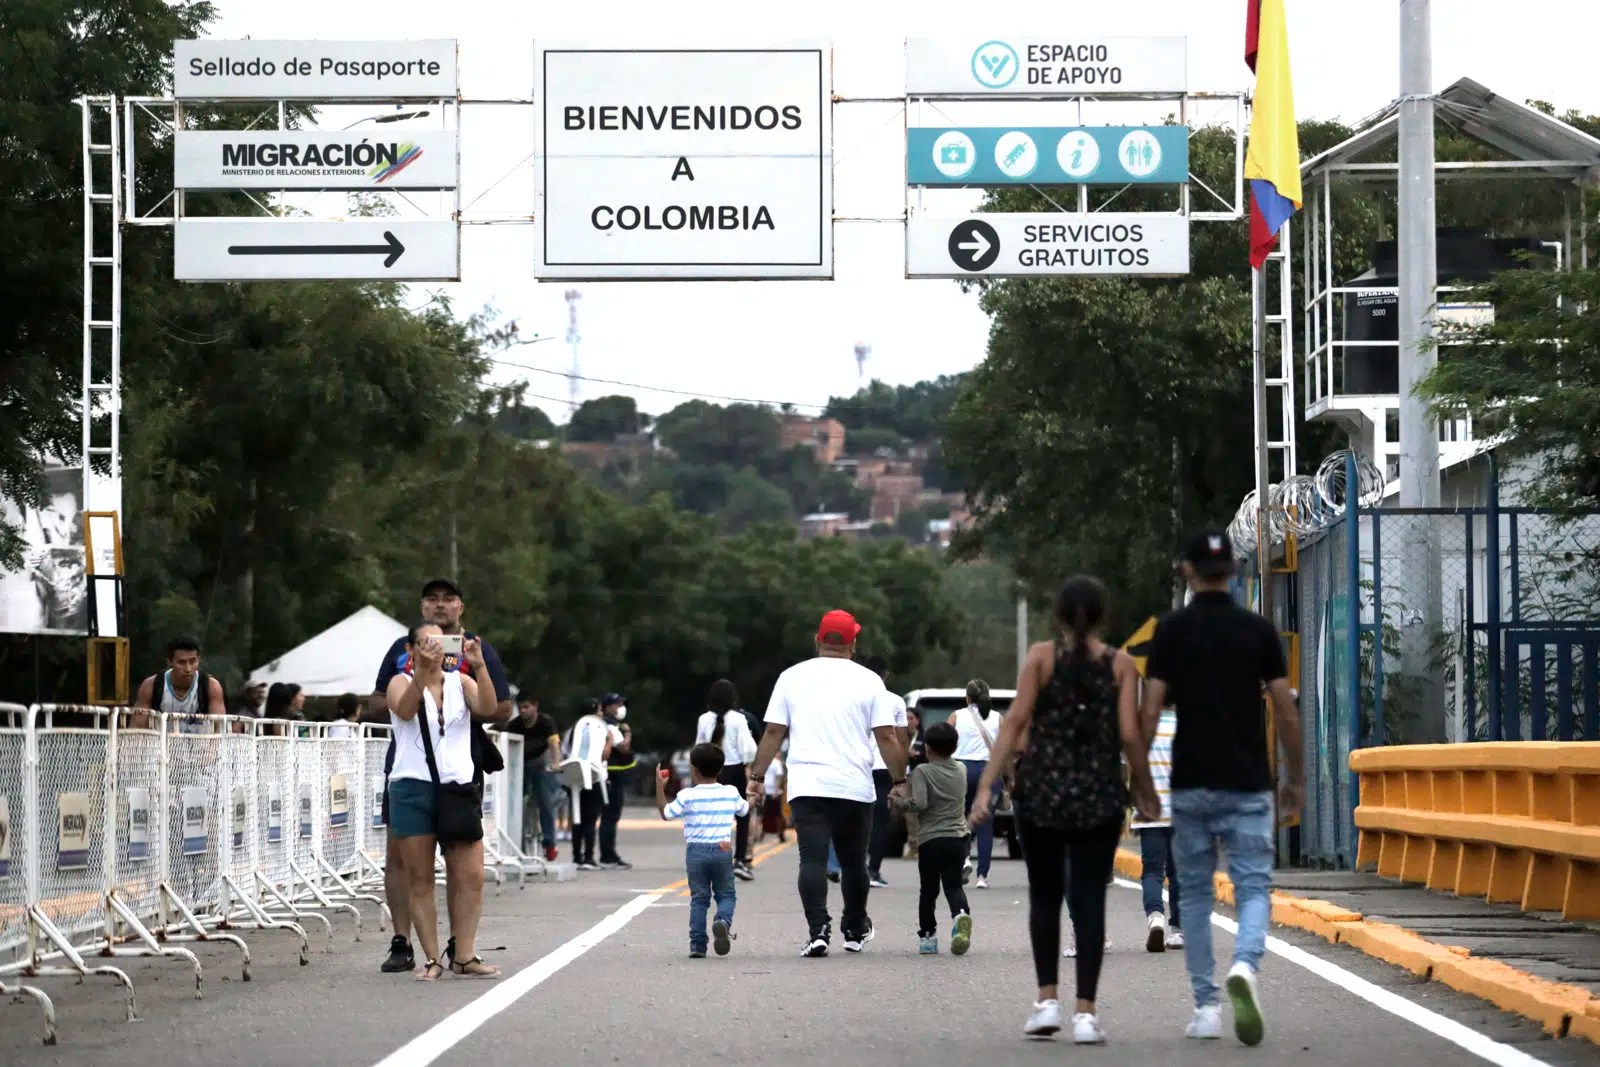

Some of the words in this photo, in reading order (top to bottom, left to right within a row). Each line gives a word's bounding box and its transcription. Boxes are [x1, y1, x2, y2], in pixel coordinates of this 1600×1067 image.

[1027, 44, 1107, 63] ESPACIO
[189, 56, 277, 77] Sellado
[283, 56, 312, 76] de
[320, 57, 441, 81] Pasaporte
[1027, 67, 1052, 85] DE
[1057, 66, 1122, 85] APOYO
[564, 105, 802, 131] BIENVENIDOS
[222, 138, 398, 167] MIGRACIÓN
[671, 155, 695, 182] A
[591, 205, 775, 231] COLOMBIA
[1024, 224, 1143, 243] SERVICIOS
[1018, 247, 1150, 267] GRATUITOS
